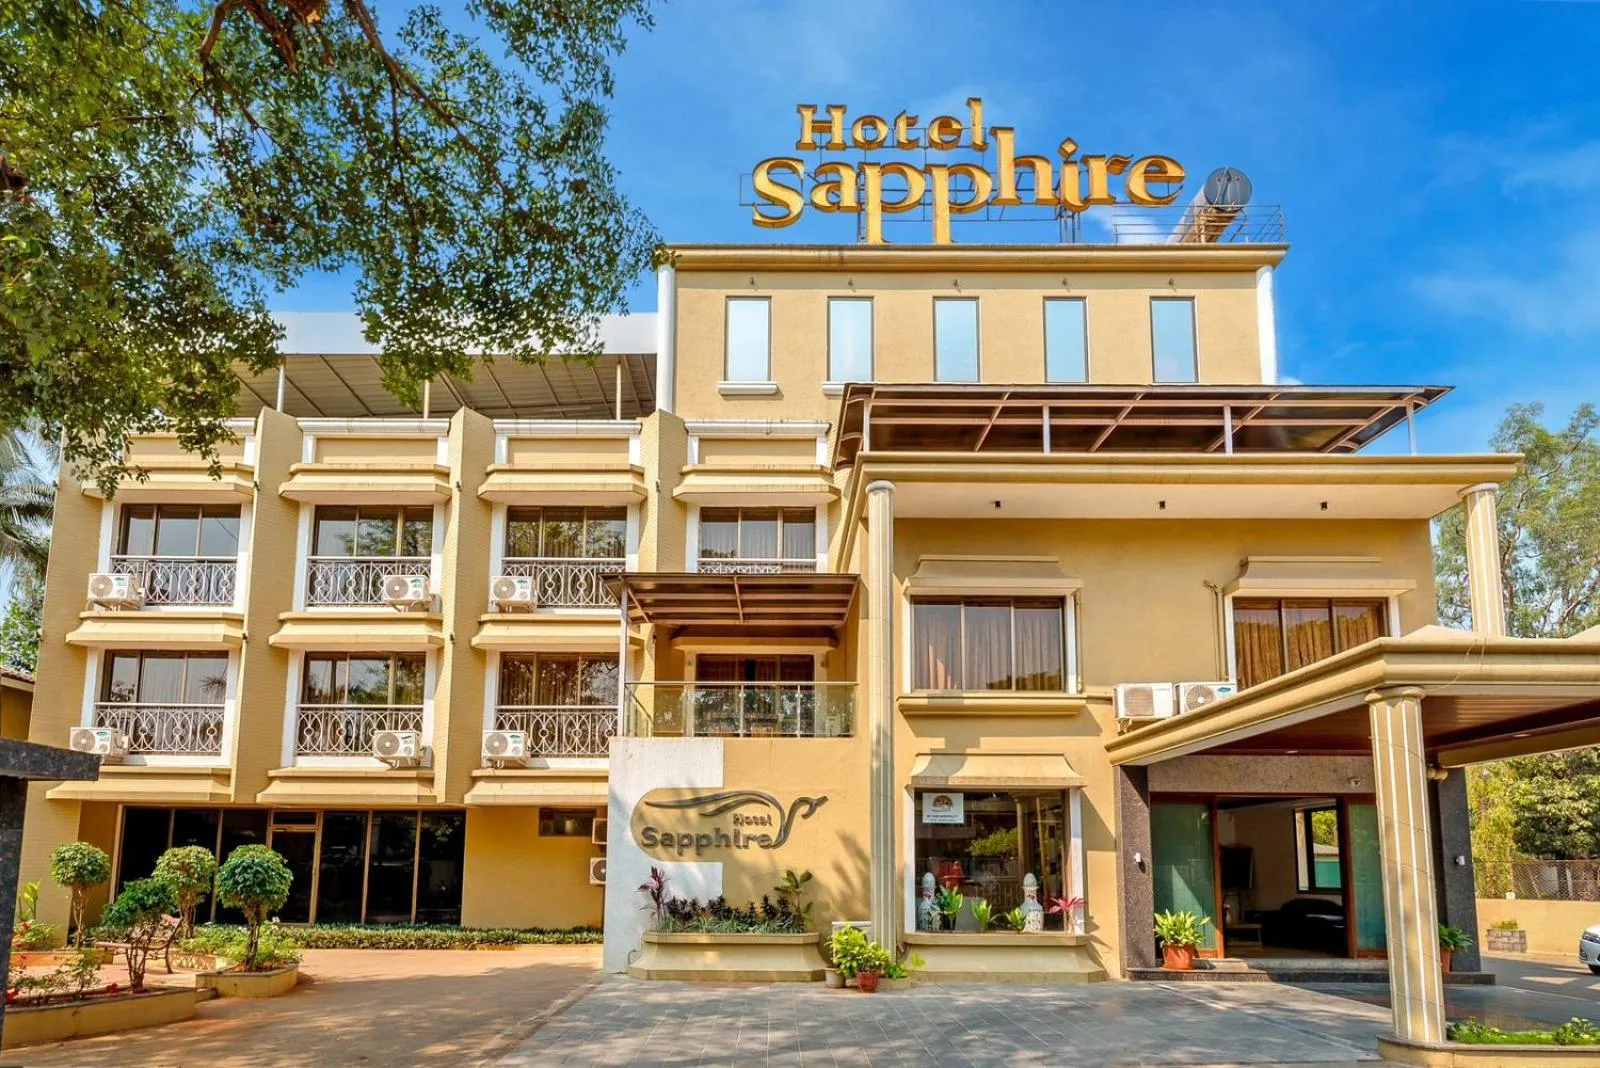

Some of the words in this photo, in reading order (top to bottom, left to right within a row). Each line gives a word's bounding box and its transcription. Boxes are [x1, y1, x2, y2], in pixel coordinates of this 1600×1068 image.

[796, 97, 988, 152] Hotel
[752, 127, 1186, 244] Sapphire
[641, 826, 773, 857] Sapphire
